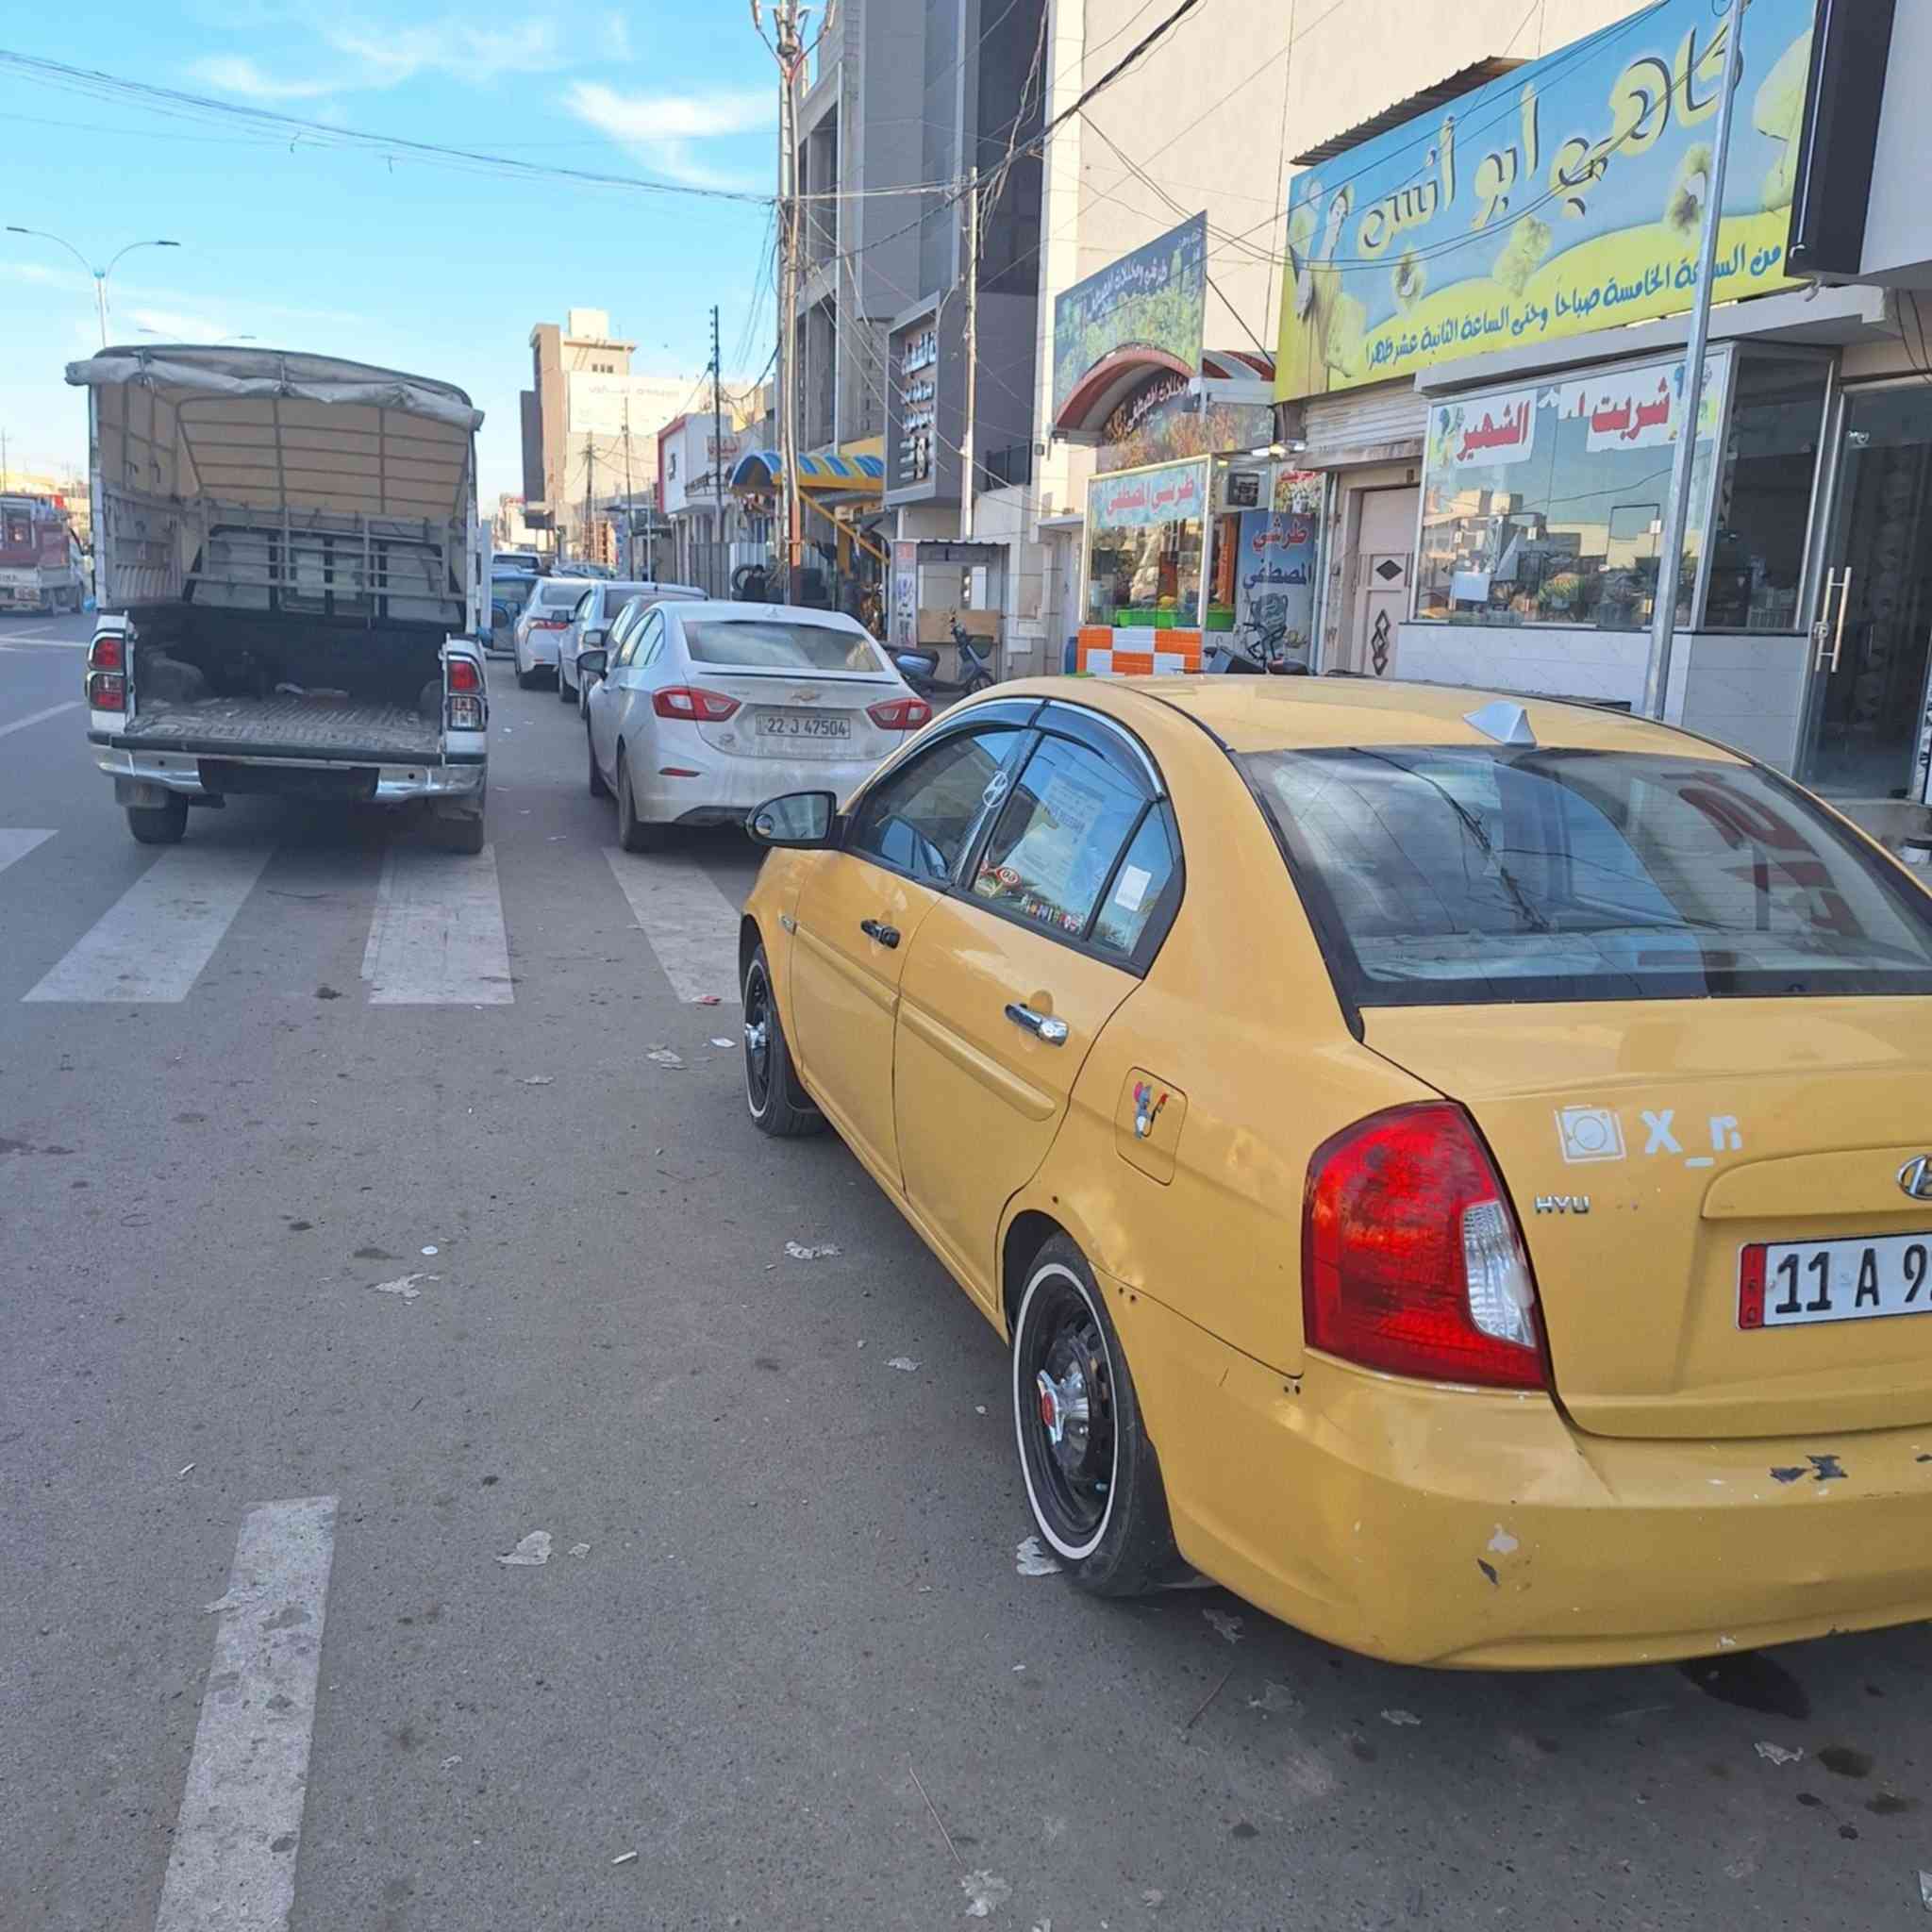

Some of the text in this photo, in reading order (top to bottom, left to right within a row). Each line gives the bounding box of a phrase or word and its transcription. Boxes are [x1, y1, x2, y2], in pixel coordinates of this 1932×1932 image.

[1749, 243, 1782, 277] من
[1602, 262, 1671, 308] الخامسة
[1420, 316, 1459, 354] الثانية
[1461, 304, 1510, 341] الساعة
[1393, 333, 1418, 366] عشر
[1456, 397, 1532, 462] الشهير
[1251, 516, 1308, 553] طرشي
[767, 717, 785, 734] 22
[804, 718, 846, 737] 47504
[1535, 1192, 1591, 1215] HYU
[1774, 1242, 1932, 1315] 11 A 9
